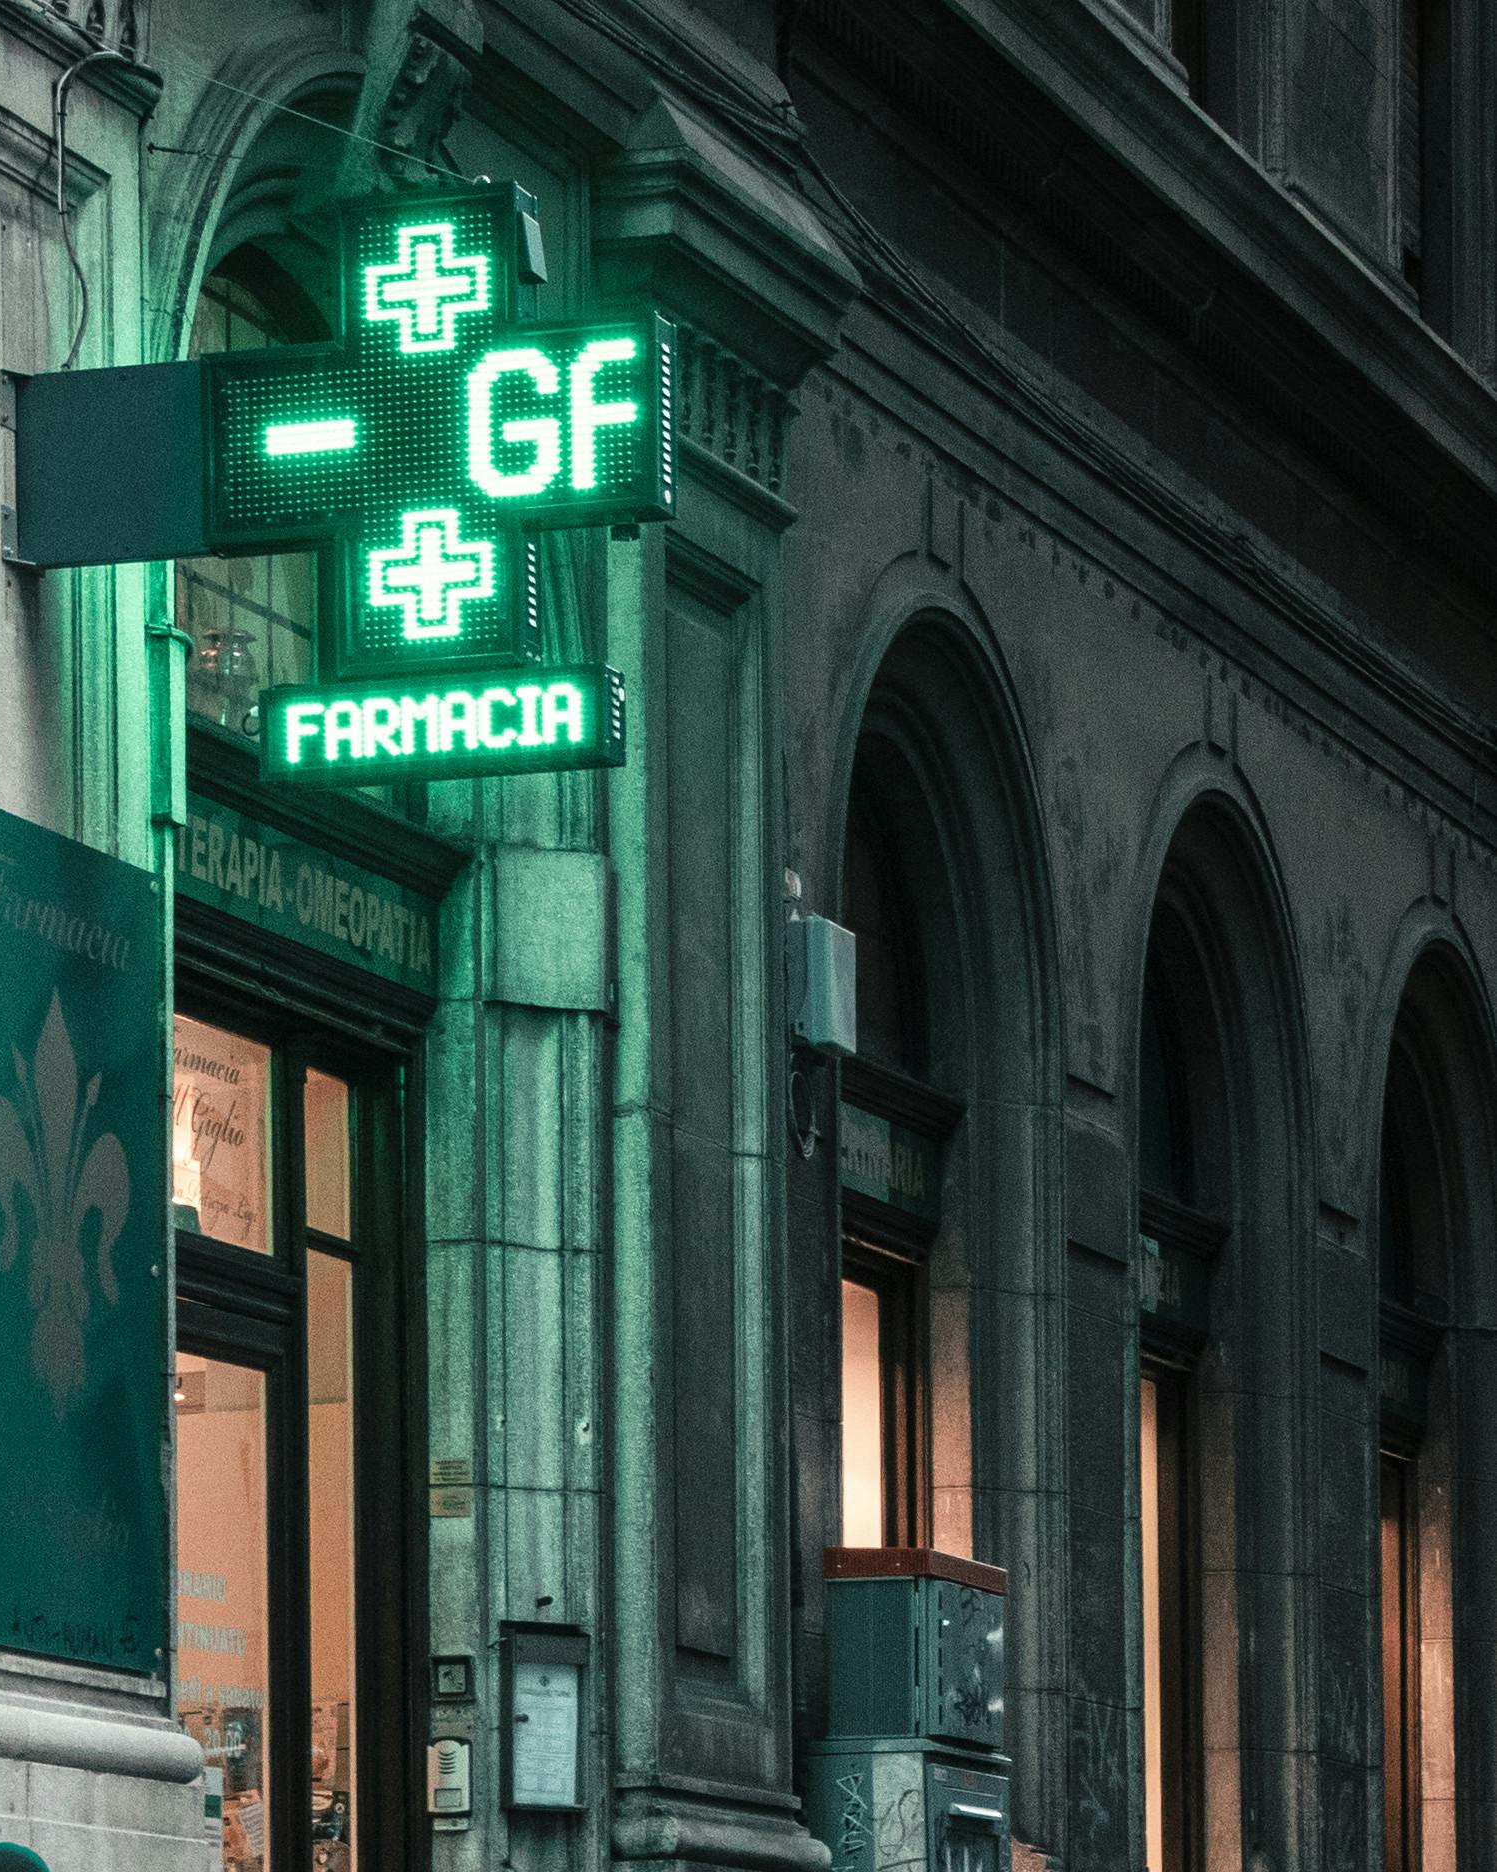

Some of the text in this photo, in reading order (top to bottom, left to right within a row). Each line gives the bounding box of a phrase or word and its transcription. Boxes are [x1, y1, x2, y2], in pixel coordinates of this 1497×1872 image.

[466, 338, 639, 500] GF
[284, 682, 585, 765] FARMACIA
[173, 1047, 240, 1086] armacia
